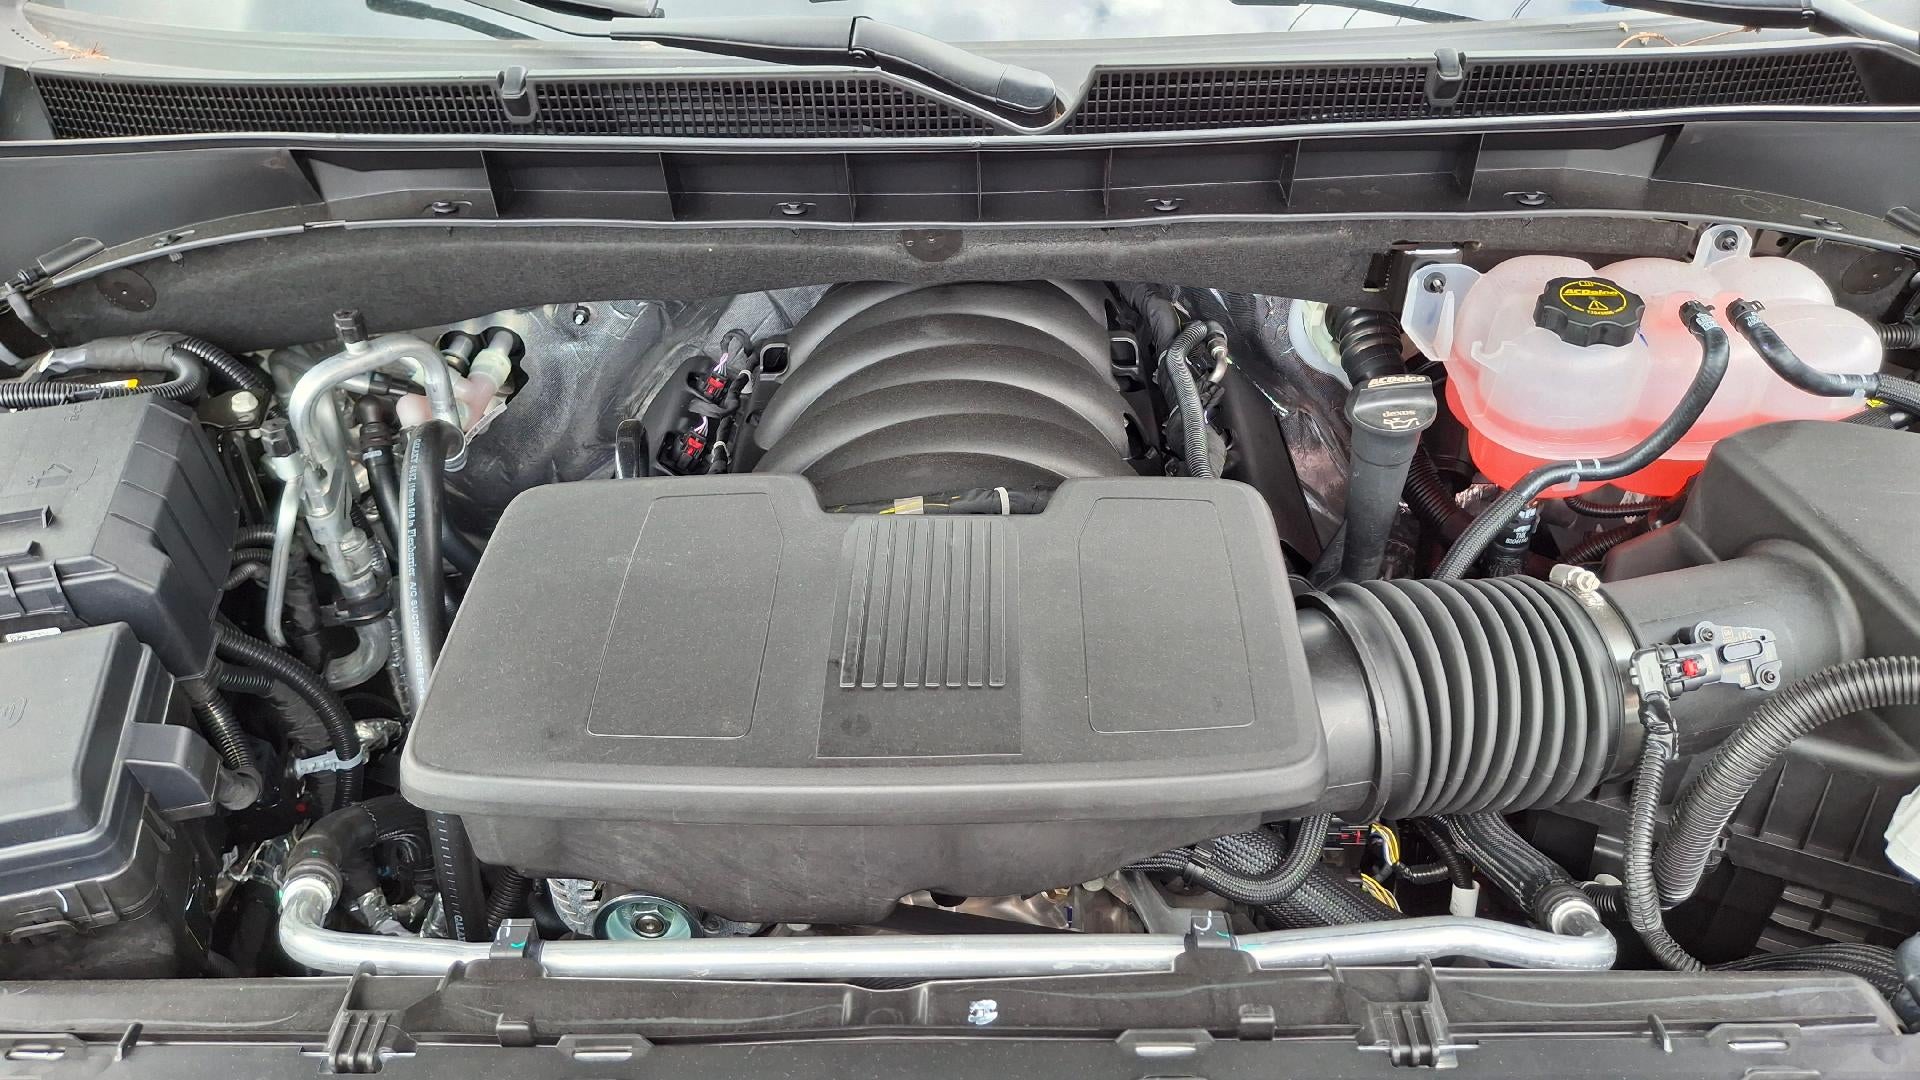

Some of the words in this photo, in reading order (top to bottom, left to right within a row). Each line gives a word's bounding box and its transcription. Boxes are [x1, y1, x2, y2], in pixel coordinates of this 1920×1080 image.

[1368, 375, 1426, 387] ACDelco
[408, 581, 418, 597] A/C
[410, 599, 421, 645] SUCTION
